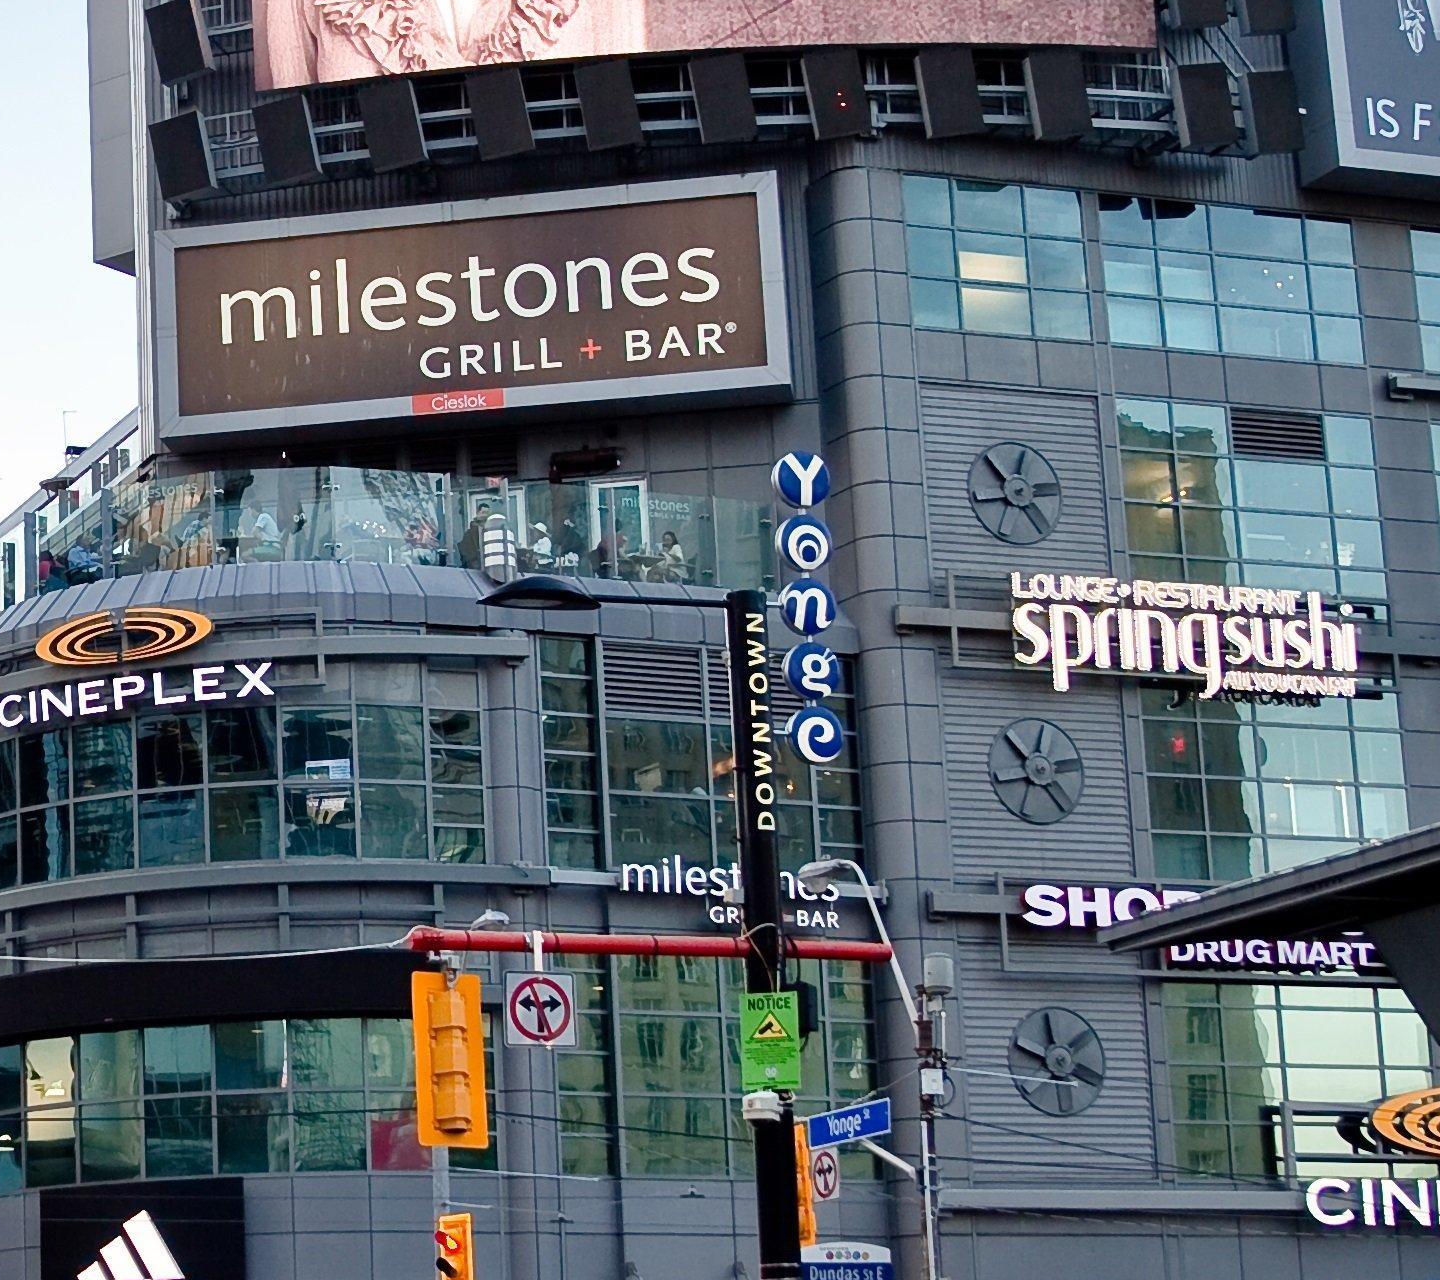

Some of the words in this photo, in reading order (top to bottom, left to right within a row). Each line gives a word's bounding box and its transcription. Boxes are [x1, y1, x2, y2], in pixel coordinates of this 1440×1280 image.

[1364, 97, 1399, 140] IS
[1412, 103, 1435, 140] F
[221, 247, 719, 344] milestones
[420, 337, 563, 379] GRILL
[431, 394, 486, 410] Cieslok
[782, 452, 836, 763] Yonge
[1011, 571, 1117, 603] LOUNGE
[1133, 580, 1301, 616] RESTAURANT
[746, 613, 775, 831] DOWNTOWN
[622, 855, 839, 902] milestnes
[796, 911, 839, 928] BAR
[1171, 939, 1274, 963] DRUG
[1279, 940, 1377, 965] MART
[747, 997, 791, 1012] NOTICE
[827, 1114, 861, 1137] Yonge
[877, 1268, 882, 1280] E
